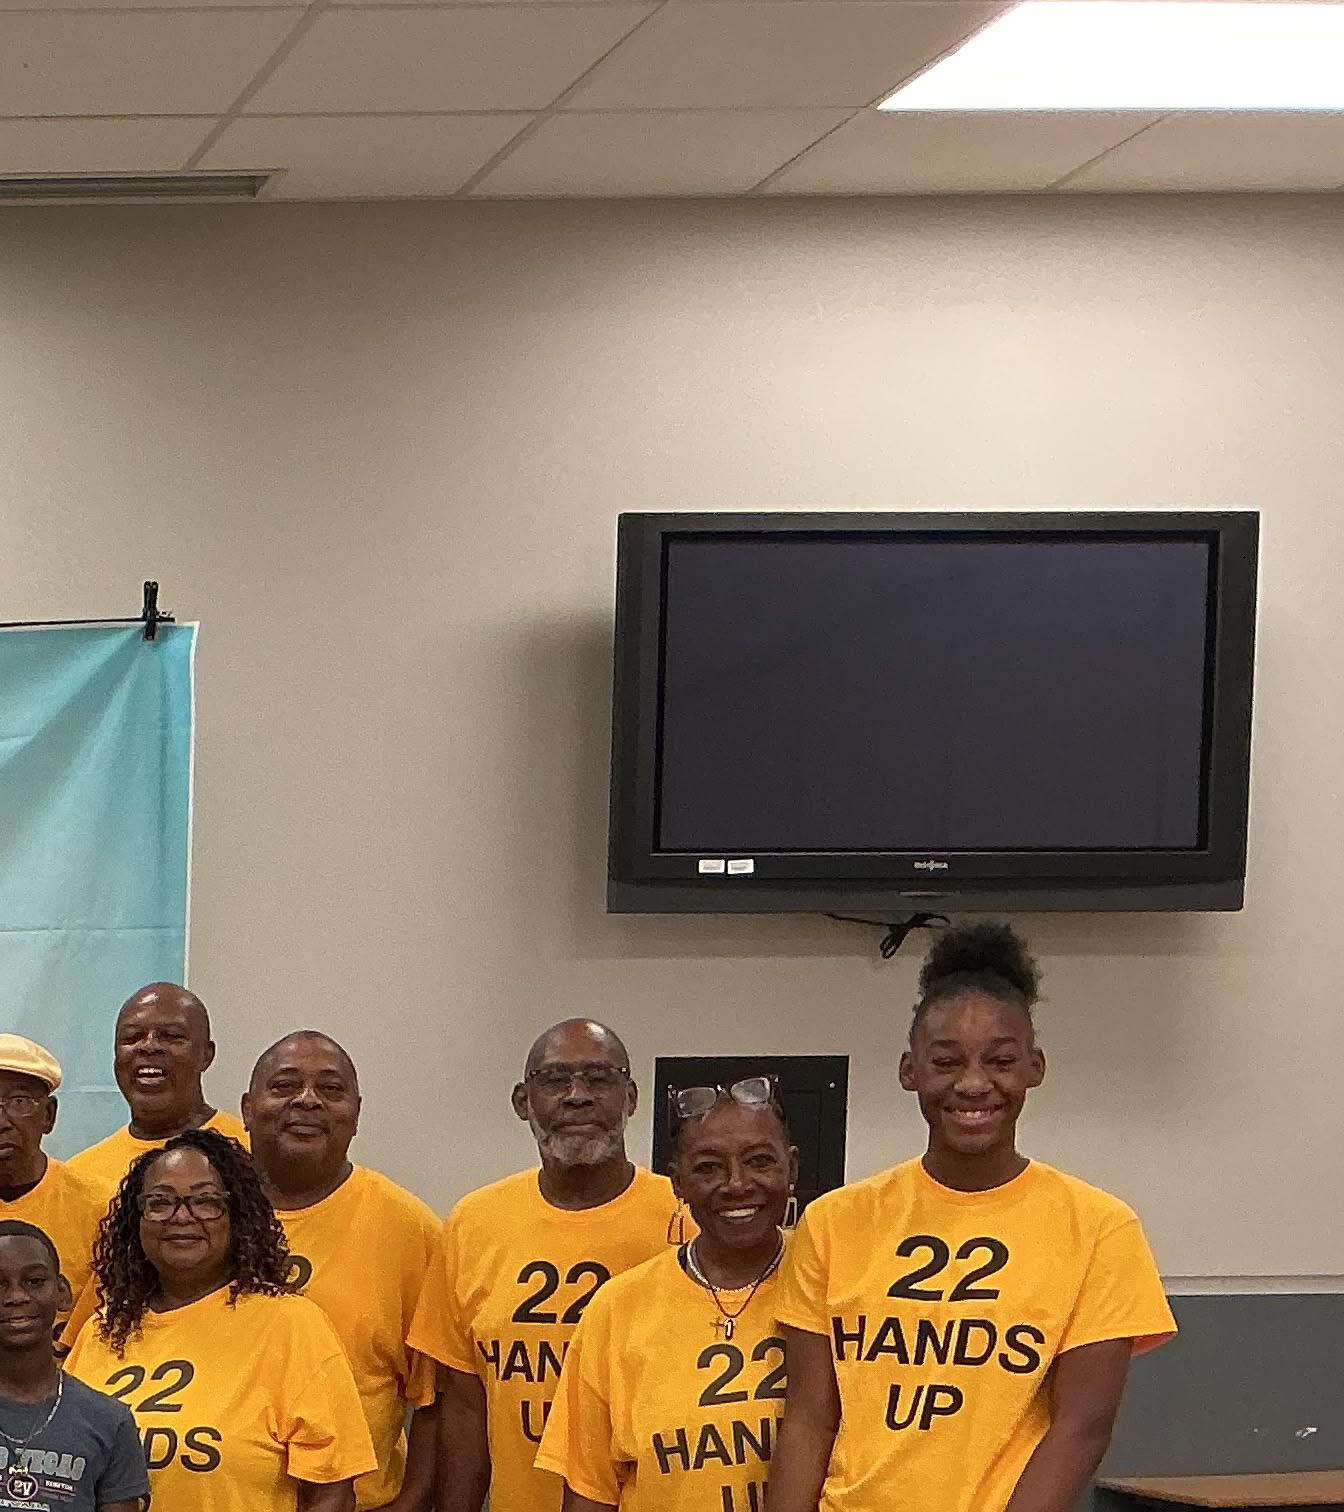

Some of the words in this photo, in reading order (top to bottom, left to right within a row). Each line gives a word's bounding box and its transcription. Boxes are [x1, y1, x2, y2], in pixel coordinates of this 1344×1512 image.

[512, 1261, 611, 1325] 22
[887, 1235, 1009, 1302] 22
[697, 1336, 788, 1407] 22
[831, 1315, 1047, 1375] HANDS
[884, 1385, 964, 1431] UP
[652, 1418, 788, 1474] HAN
